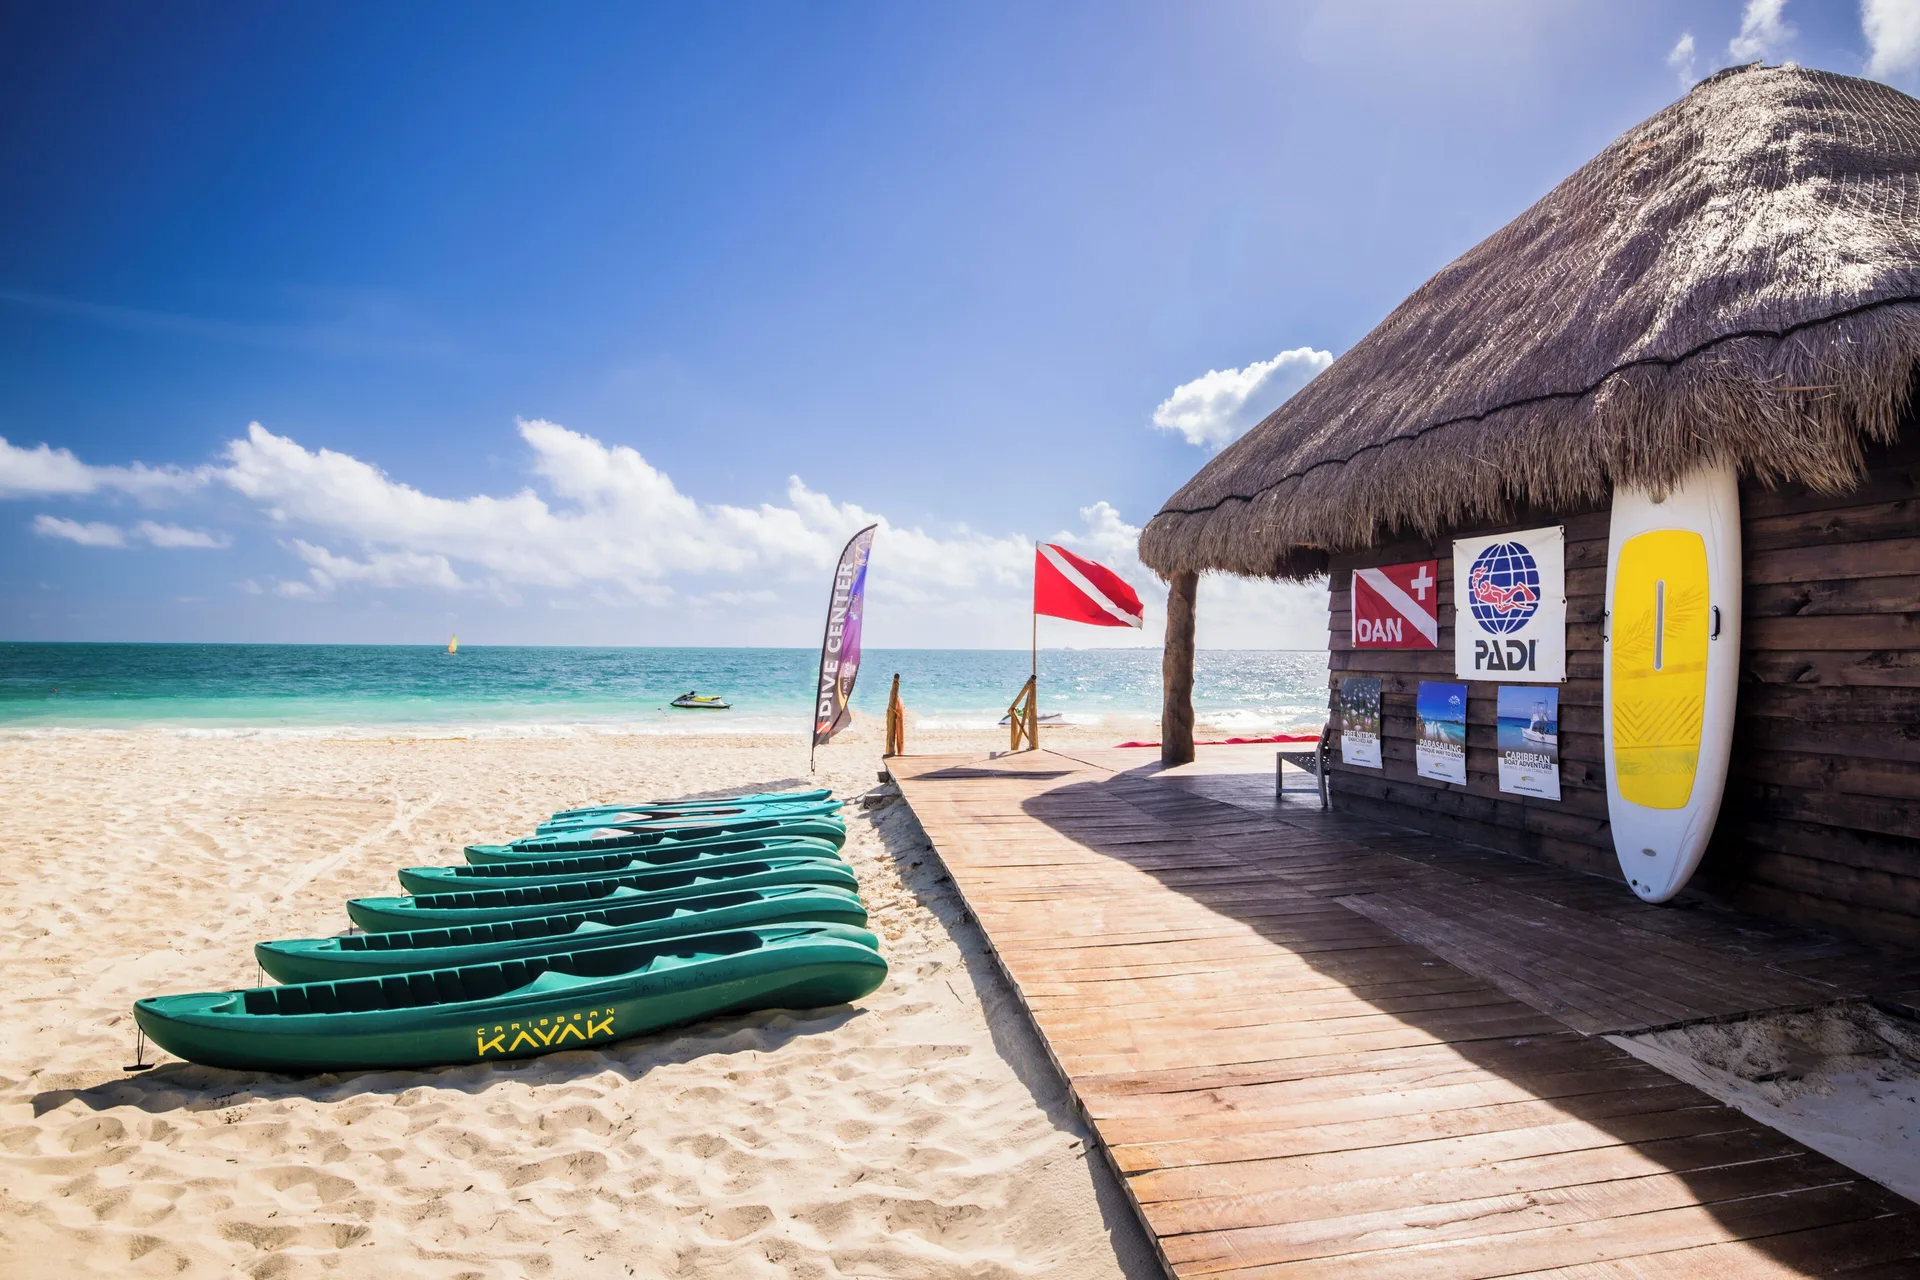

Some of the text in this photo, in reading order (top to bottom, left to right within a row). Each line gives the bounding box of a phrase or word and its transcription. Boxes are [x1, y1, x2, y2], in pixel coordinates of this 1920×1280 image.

[827, 562, 854, 653] CENTER
[1357, 618, 1403, 643] DAN
[1475, 639, 1536, 671] PADI
[819, 660, 839, 717] DIVE
[1343, 729, 1377, 740] FREE NITROX
[1348, 736, 1367, 744] ENRICHED
[1419, 738, 1462, 753] PARASAILING
[1420, 747, 1435, 755] UNIQUE
[1451, 751, 1465, 760] ENJOY
[1503, 758, 1518, 766] BOAT
[1518, 760, 1553, 771] ADVENTURE
[1505, 750, 1550, 764] CARIBBEAN
[476, 1008, 615, 1036] CARIBBEAN
[477, 1016, 615, 1056] KAYAK
